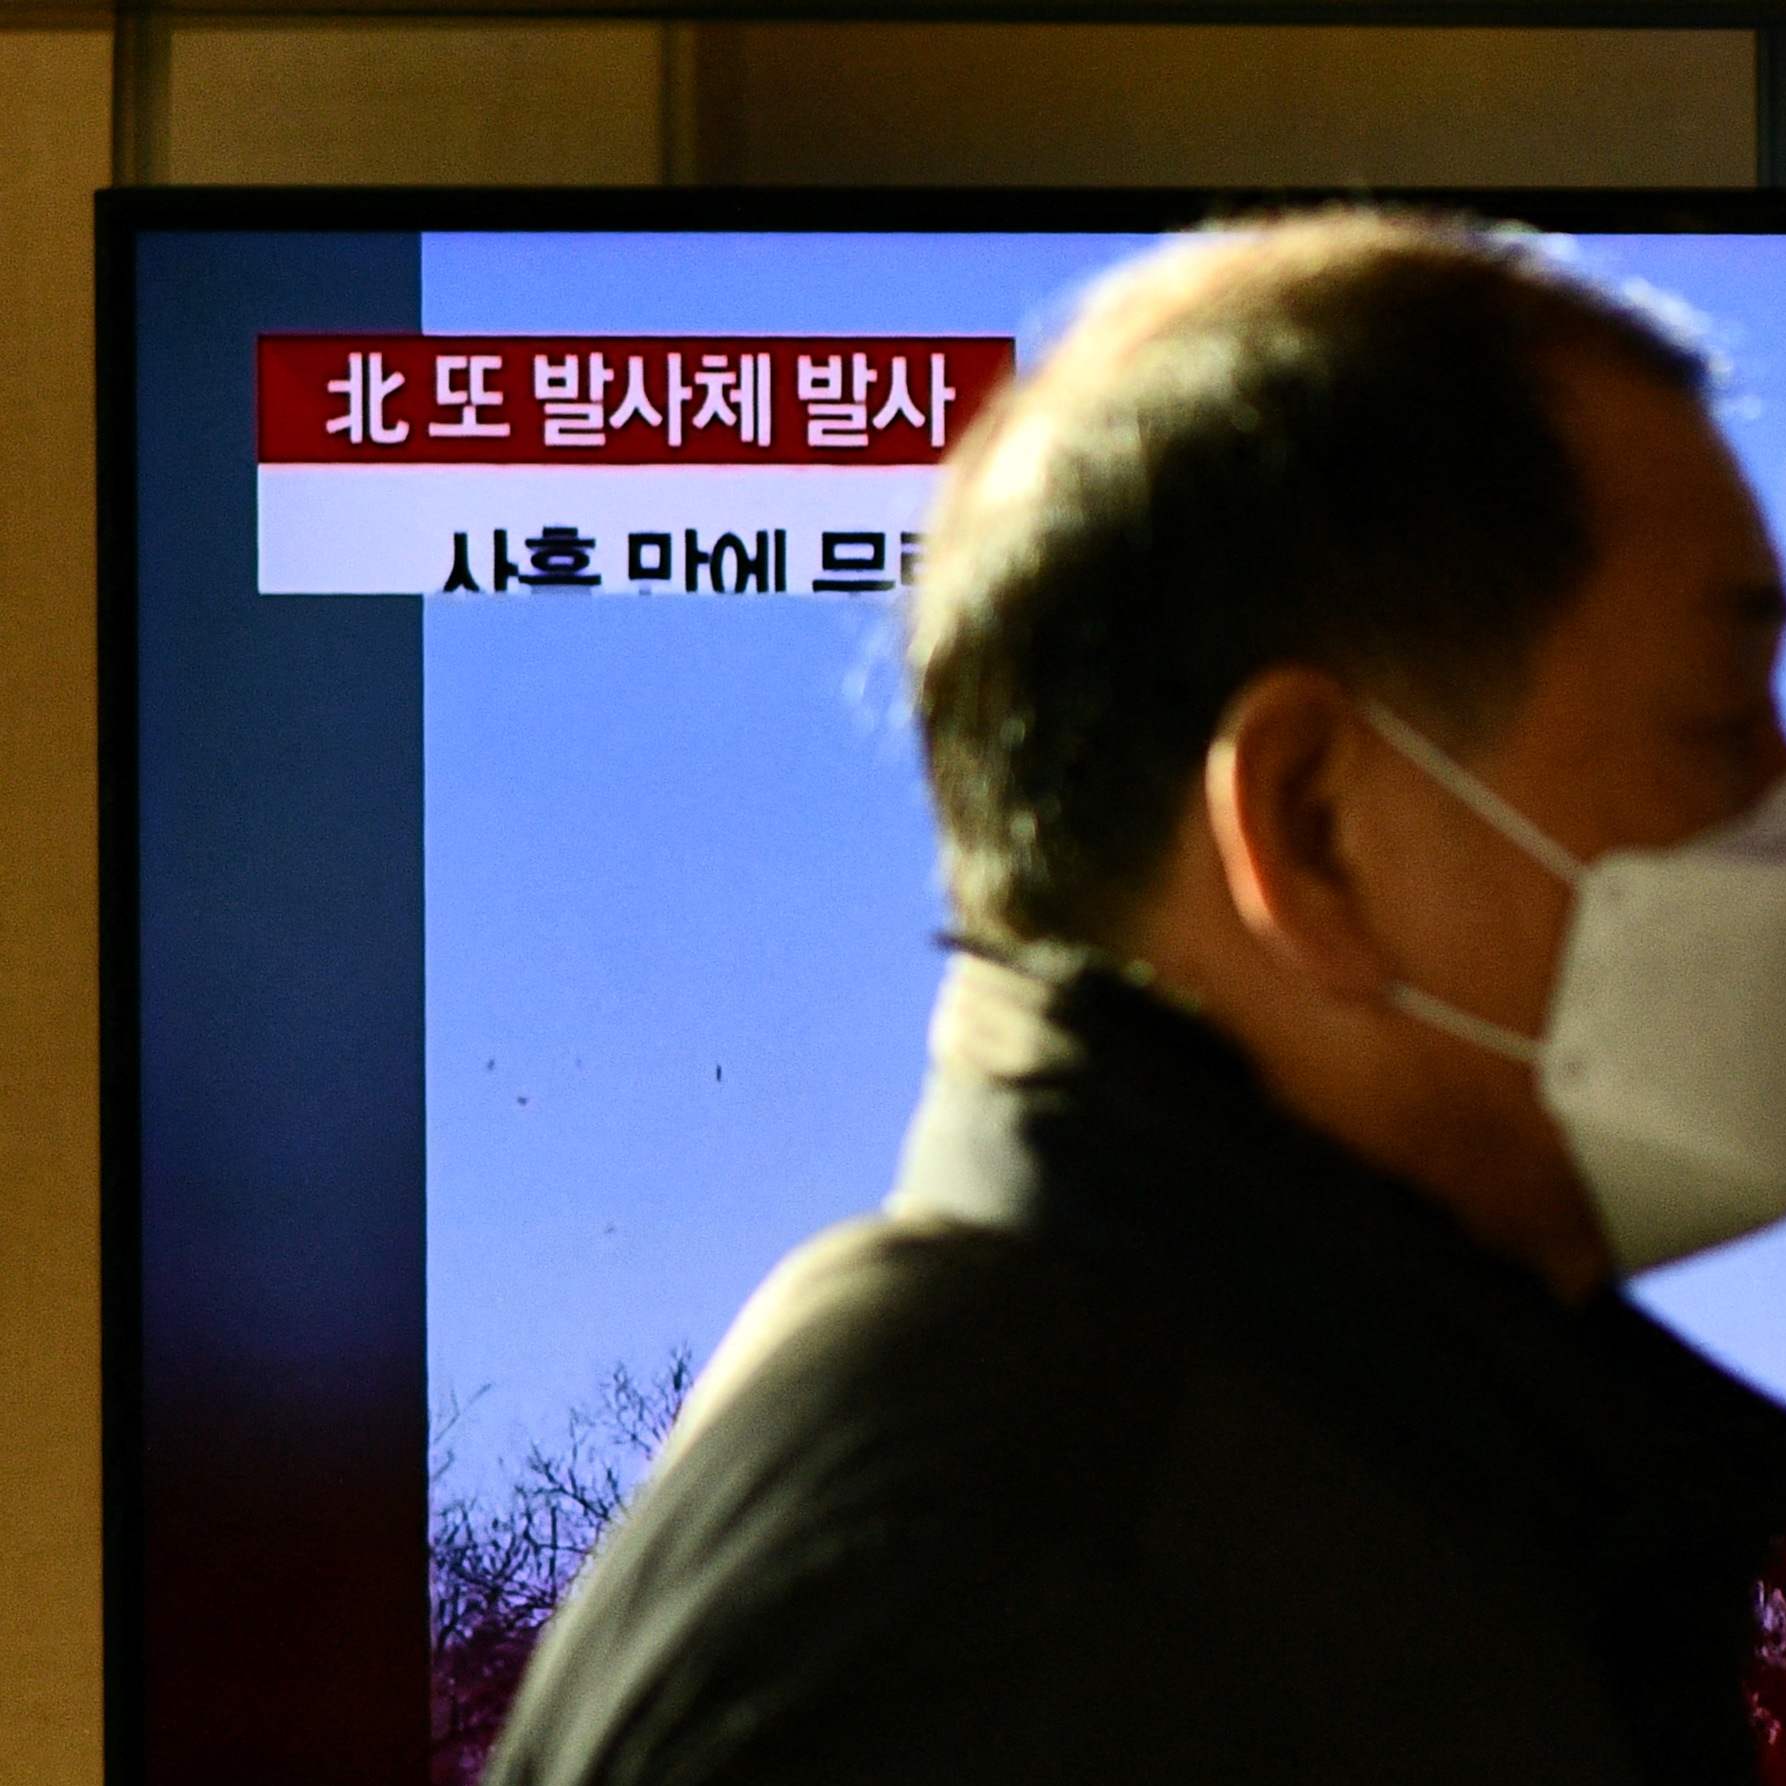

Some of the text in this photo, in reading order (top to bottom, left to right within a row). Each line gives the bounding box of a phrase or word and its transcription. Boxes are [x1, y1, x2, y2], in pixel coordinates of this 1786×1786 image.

[325, 351, 956, 448] 北 또 발사체 발사
